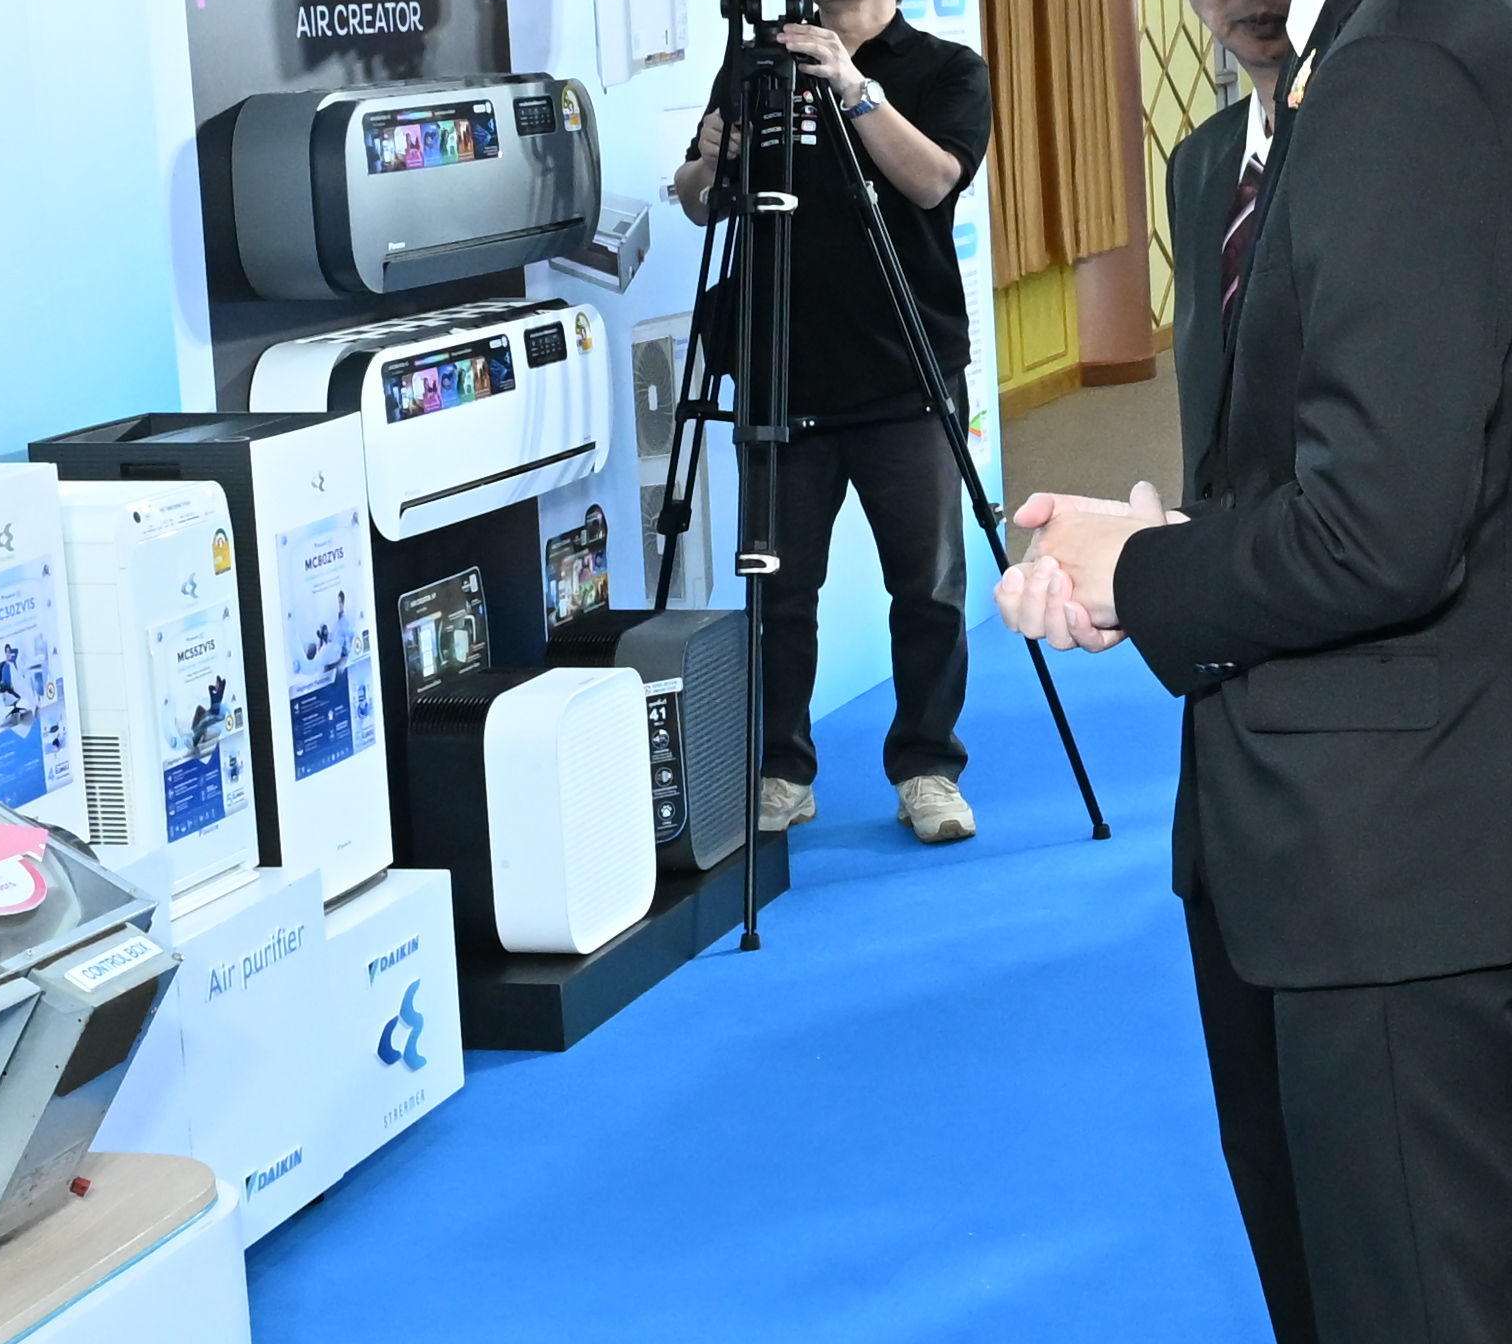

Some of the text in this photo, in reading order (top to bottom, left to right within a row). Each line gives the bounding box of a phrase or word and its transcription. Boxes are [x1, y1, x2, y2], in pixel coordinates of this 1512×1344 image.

[296, 1, 424, 38] AIR CREATOR
[648, 706, 667, 722] 41
[80, 940, 154, 981] CONTROL BOX
[207, 922, 306, 1002] Air purifier
[380, 935, 420, 972] DAIKIN
[382, 1088, 426, 1130] STREAMER
[257, 1145, 303, 1192] DAIKIN
